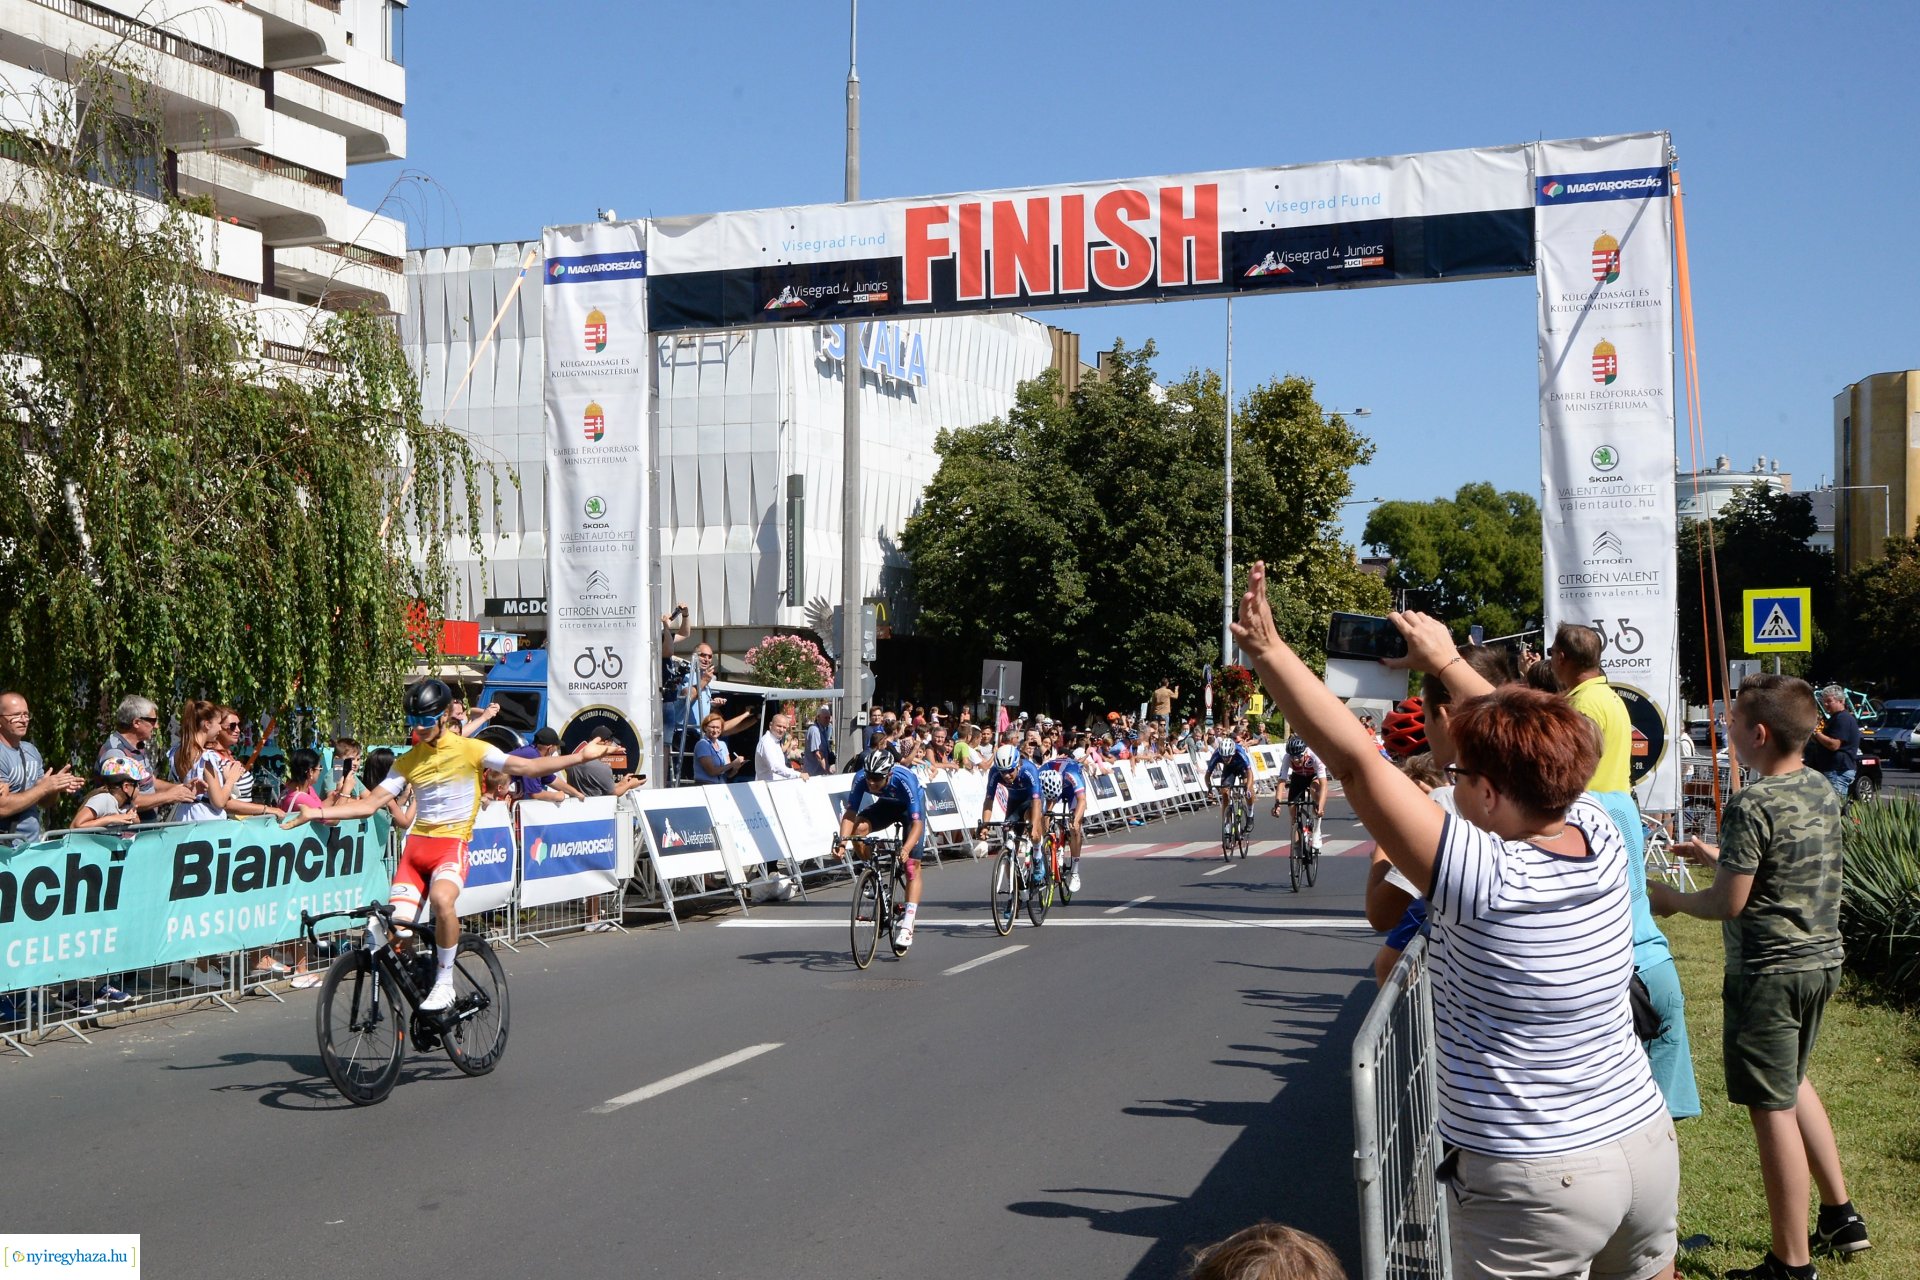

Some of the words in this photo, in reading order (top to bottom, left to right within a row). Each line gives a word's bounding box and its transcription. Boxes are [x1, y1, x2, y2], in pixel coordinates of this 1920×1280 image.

[1567, 174, 1662, 193] MAGYARORSZÁG
[1265, 196, 1336, 214] Visegrad
[1342, 193, 1381, 207] Fund
[782, 237, 846, 252] Visegrad
[850, 233, 886, 247] Fund
[906, 184, 1220, 302] FINISH
[1275, 248, 1330, 264] Visegrad
[1332, 247, 1340, 258] 4
[1344, 243, 1384, 257] Juniors
[567, 258, 642, 275] MAGYARORSZÁG
[792, 282, 840, 298] Visegrad
[842, 283, 849, 293] 4
[853, 280, 888, 292] Juniors
[1561, 290, 1637, 302] KÜLGAZDASÁGI
[1639, 287, 1650, 297] ÉS
[621, 357, 630, 366] ÉS
[1550, 391, 1587, 402] EMBERI
[1565, 400, 1648, 412] MINISZTÉRIUMA
[553, 447, 580, 457] EMBERI
[564, 455, 628, 465] MINISZTÉRIUMA
[1589, 475, 1623, 483] ŠKODA
[1558, 486, 1602, 497] VALENT
[1604, 484, 1630, 495] AUTÓ
[1560, 498, 1655, 512] valentauto.hu
[560, 532, 590, 541] VALENT
[591, 531, 616, 540] AUTÓ
[561, 543, 634, 554] valentauto.hu
[1558, 572, 1609, 585] CITROËN
[1612, 571, 1659, 583] VALENT
[1559, 588, 1660, 599] citroenvalent.hu
[558, 605, 598, 617] CITROËN
[601, 605, 637, 616] VALENT
[560, 621, 637, 629] citroenvalent.hu
[568, 682, 628, 690] BRINGASPORT
[550, 835, 613, 858] MAGYARORSZÁG
[169, 823, 366, 901] Bianchi
[167, 901, 277, 942] PASSIONE
[287, 887, 363, 921] CELESTE
[7, 928, 117, 967] CELESTE
